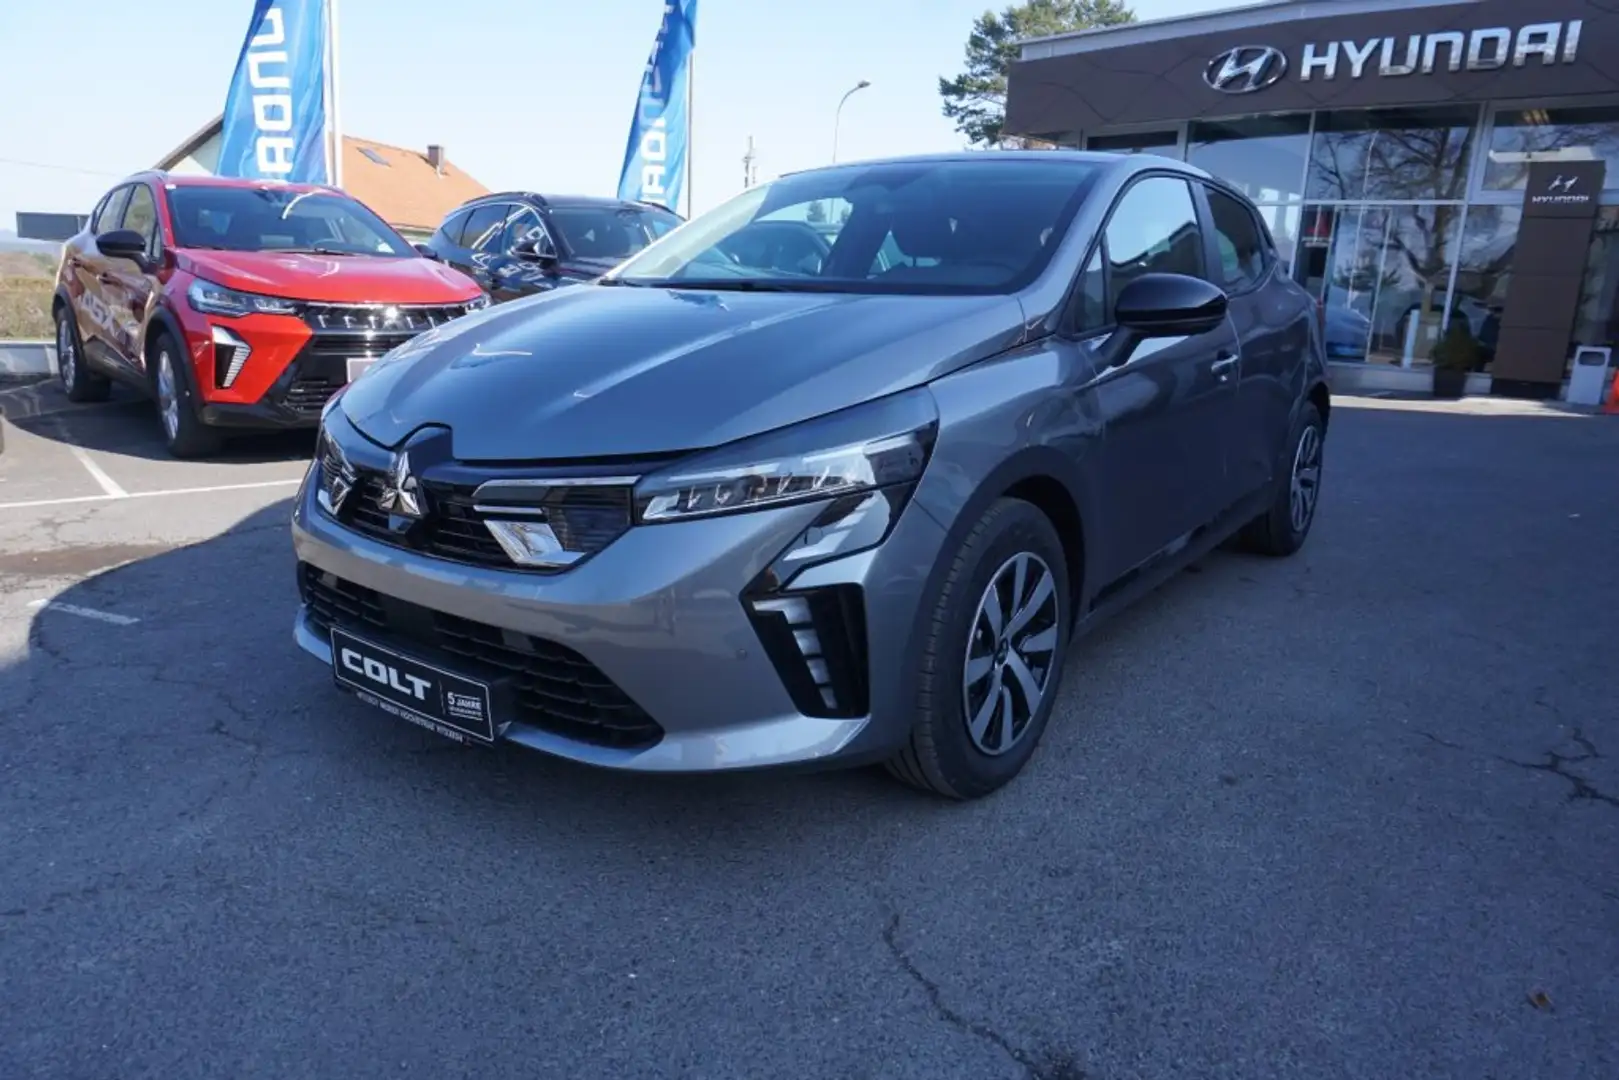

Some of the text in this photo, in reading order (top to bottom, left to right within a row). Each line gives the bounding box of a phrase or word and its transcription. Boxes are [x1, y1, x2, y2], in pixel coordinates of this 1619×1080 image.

[1300, 19, 1583, 81] HYUNDAI
[341, 647, 432, 700] COLT
[447, 691, 456, 705] 5
